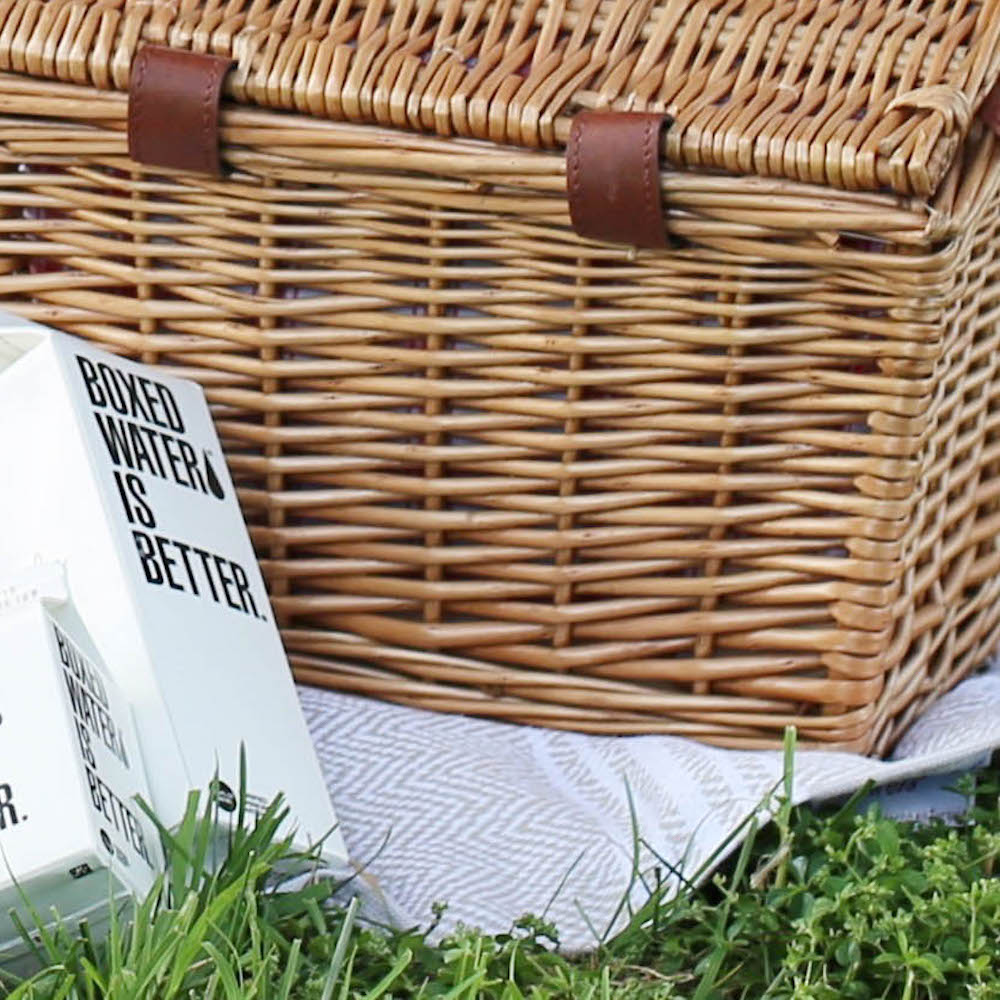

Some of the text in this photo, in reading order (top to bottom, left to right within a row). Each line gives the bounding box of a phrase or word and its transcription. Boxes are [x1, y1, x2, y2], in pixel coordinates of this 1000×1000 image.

[76, 355, 185, 434] BOXED
[94, 411, 209, 495] WATER
[113, 470, 156, 530] IS
[132, 530, 268, 622] BETTER.
